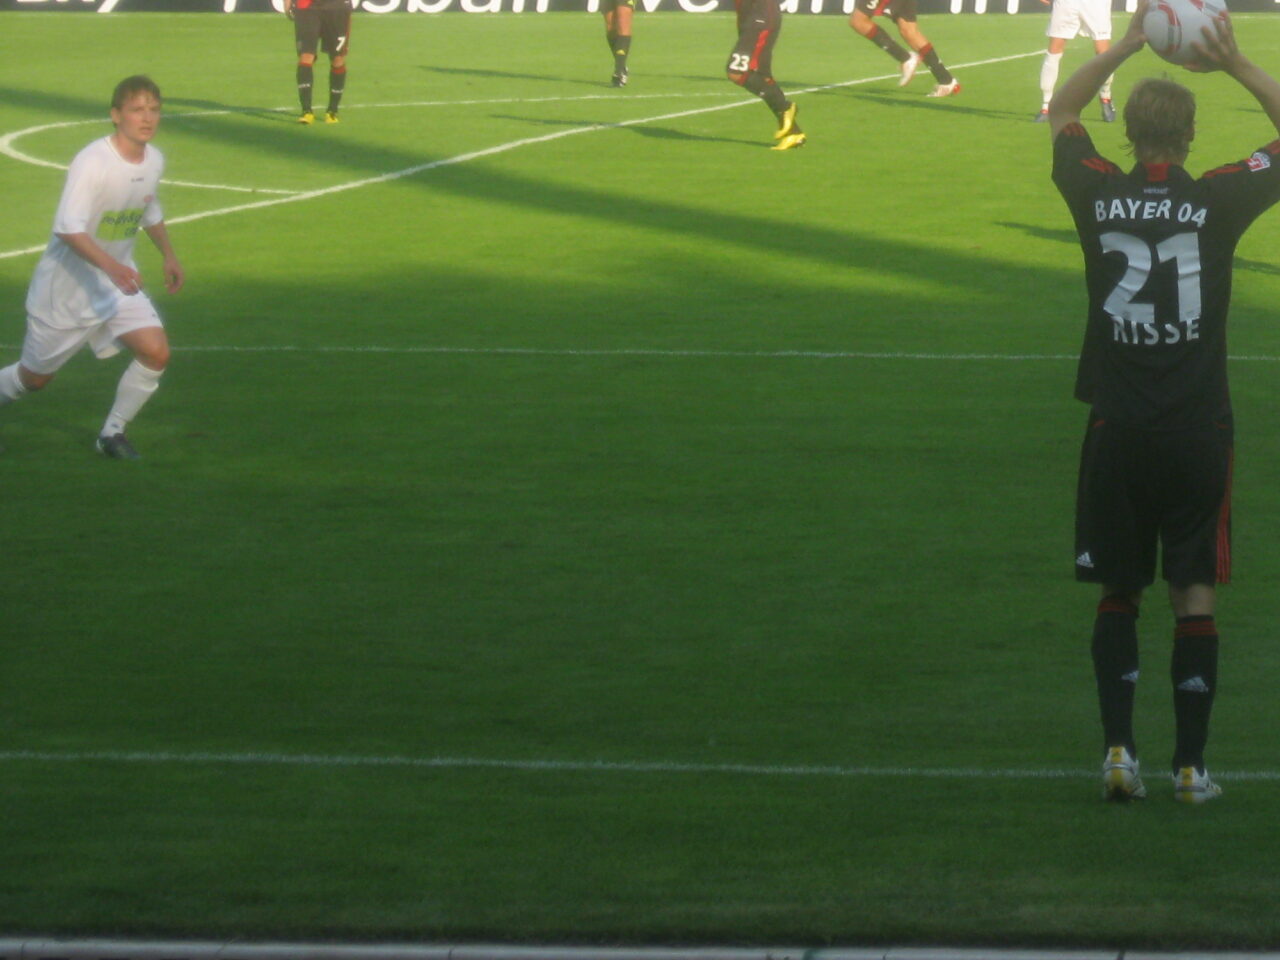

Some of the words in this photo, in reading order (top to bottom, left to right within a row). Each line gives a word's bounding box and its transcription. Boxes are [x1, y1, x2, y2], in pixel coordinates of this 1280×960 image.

[335, 36, 346, 52] 7
[729, 53, 750, 72] 23
[1095, 198, 1172, 222] BAYER
[1177, 202, 1208, 228] 04
[1099, 231, 1202, 324] 21
[1111, 315, 1200, 346] RISSE
